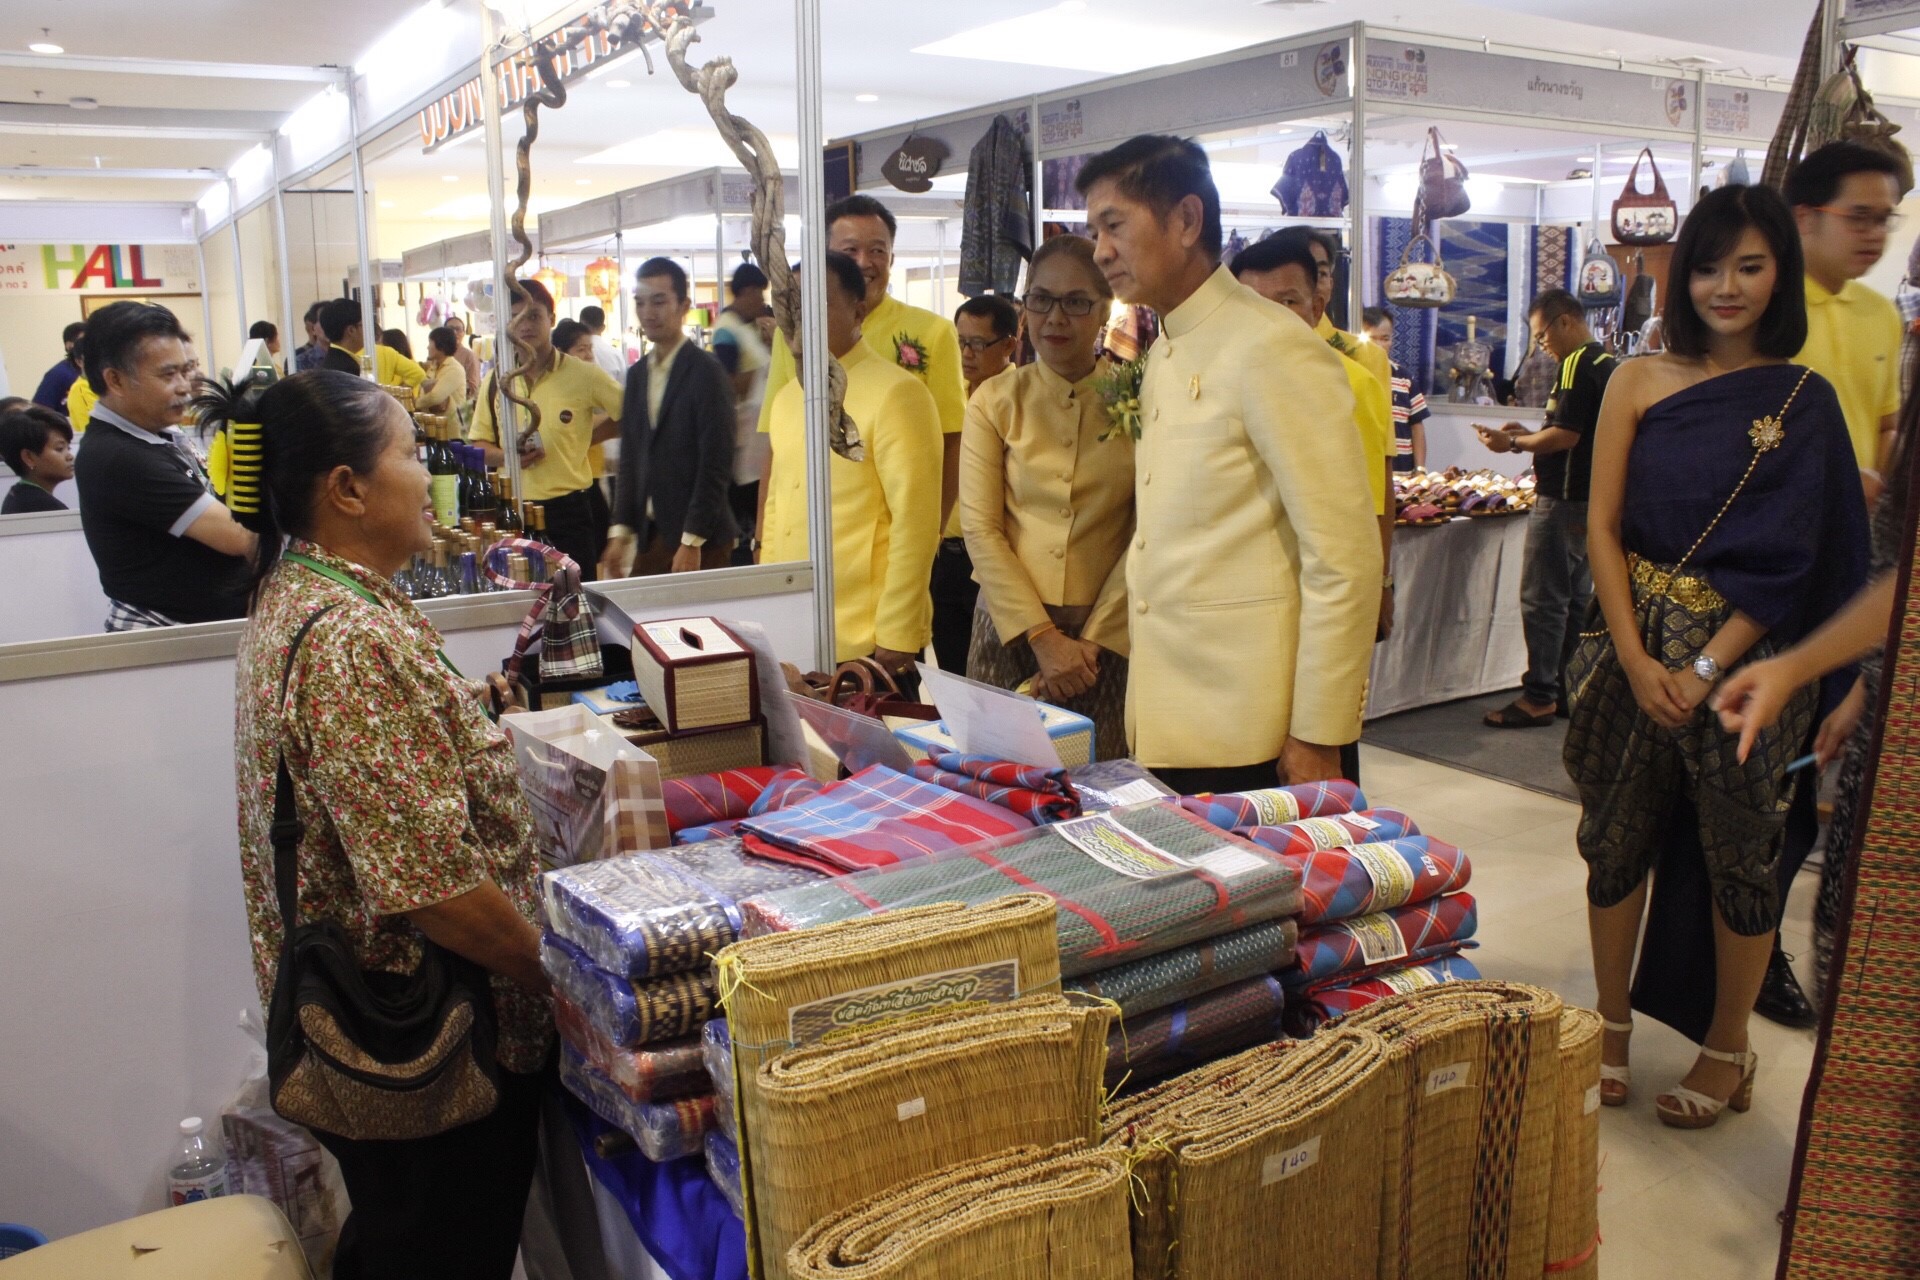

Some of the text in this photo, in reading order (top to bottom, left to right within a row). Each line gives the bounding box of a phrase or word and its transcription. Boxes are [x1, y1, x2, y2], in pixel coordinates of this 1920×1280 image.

[1284, 53, 1294, 66] 81
[1366, 67, 1400, 81] NONG
[1401, 71, 1428, 84] KHAI
[1366, 78, 1388, 89] OTOP
[1390, 80, 1407, 91] FAIR
[1527, 75, 1584, 101] แก้วนางขวัญ
[40, 245, 164, 289] HALL
[1432, 1071, 1457, 1090] 140
[1280, 1151, 1307, 1174] 140
